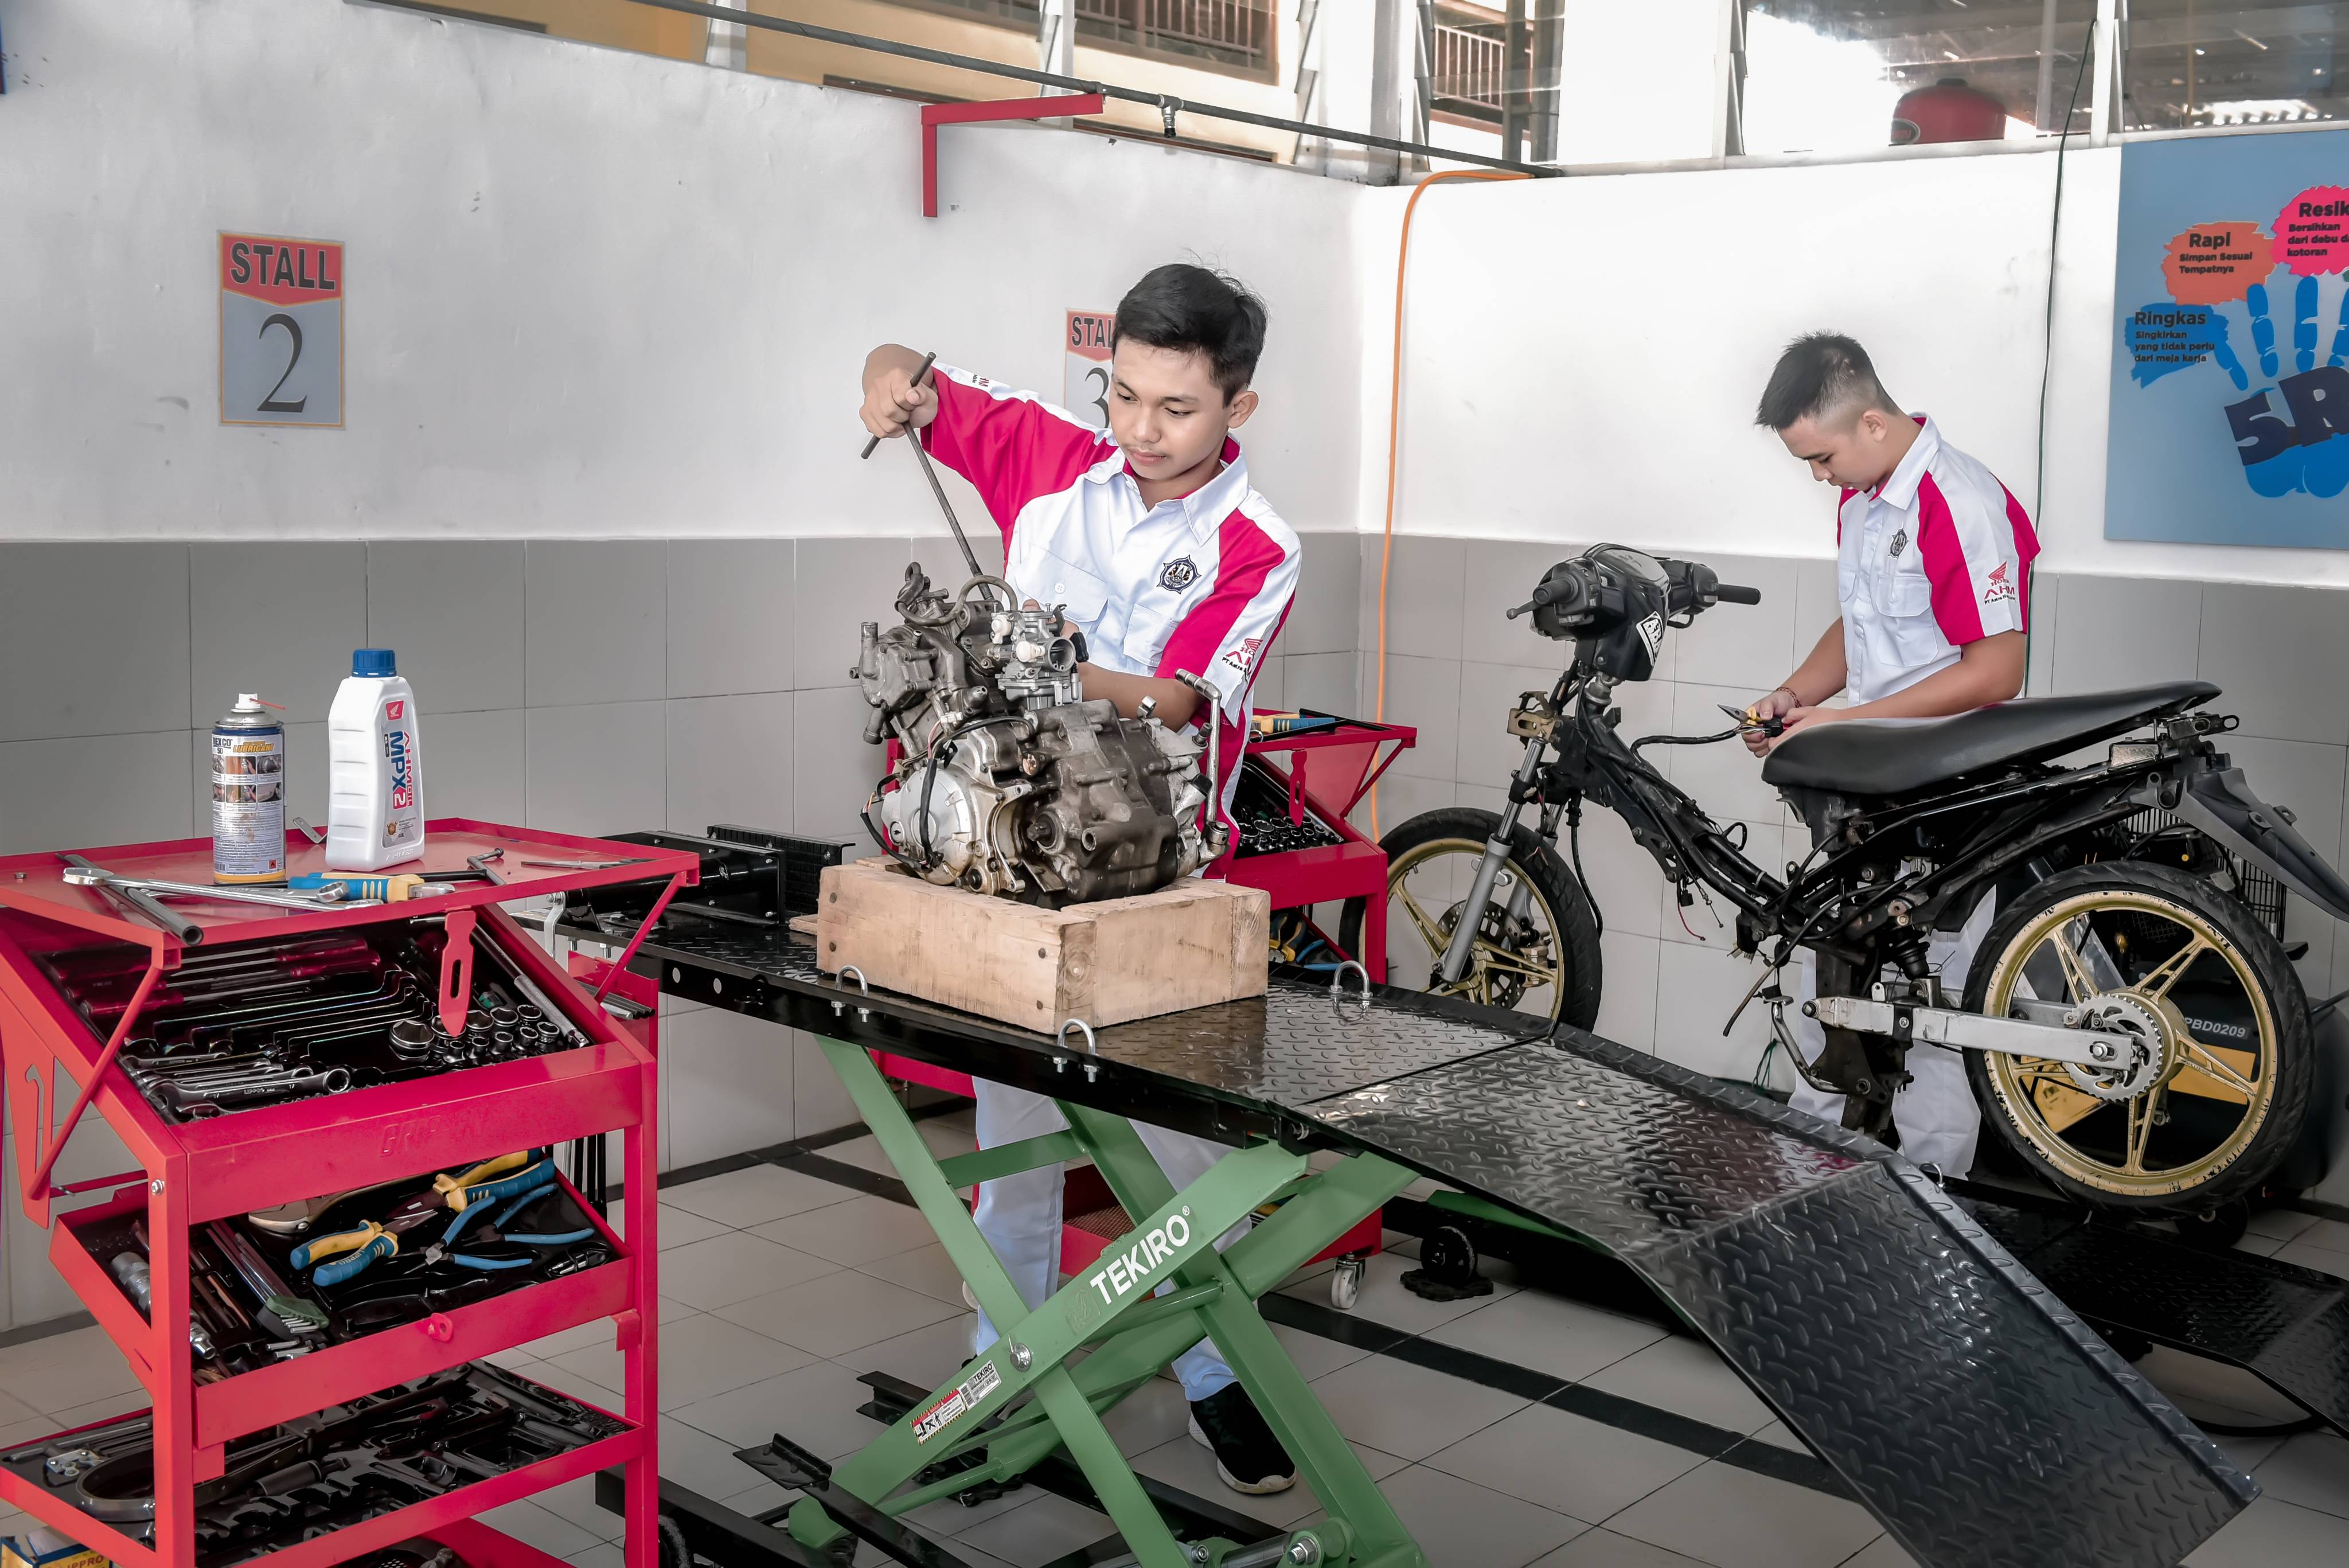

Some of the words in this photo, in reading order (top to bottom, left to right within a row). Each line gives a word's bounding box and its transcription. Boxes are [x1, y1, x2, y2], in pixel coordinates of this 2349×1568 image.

[2289, 223, 2340, 232] Bersihkan
[2189, 231, 2231, 250] Rapi
[2288, 235, 2308, 244] dari
[2311, 235, 2338, 243] debu
[2179, 253, 2217, 263] Simpan
[2219, 251, 2253, 260] Sesuai
[2287, 248, 2328, 256] kotoran
[230, 241, 335, 291] STALL
[2179, 265, 2234, 275] Tempatnya
[2135, 310, 2206, 327] Ringkas
[1071, 316, 1113, 349] STAL
[2135, 330, 2187, 340] Singkirkan
[2135, 344, 2159, 352] yang
[2161, 342, 2186, 350] tidak
[2189, 342, 2215, 351] perlu
[257, 312, 307, 413] 2
[2135, 354, 2153, 362] dari
[2156, 354, 2179, 363] meja
[2182, 354, 2207, 363] kerja
[1084, 367, 1110, 428] 3
[233, 743, 275, 753] LUBRICANT
